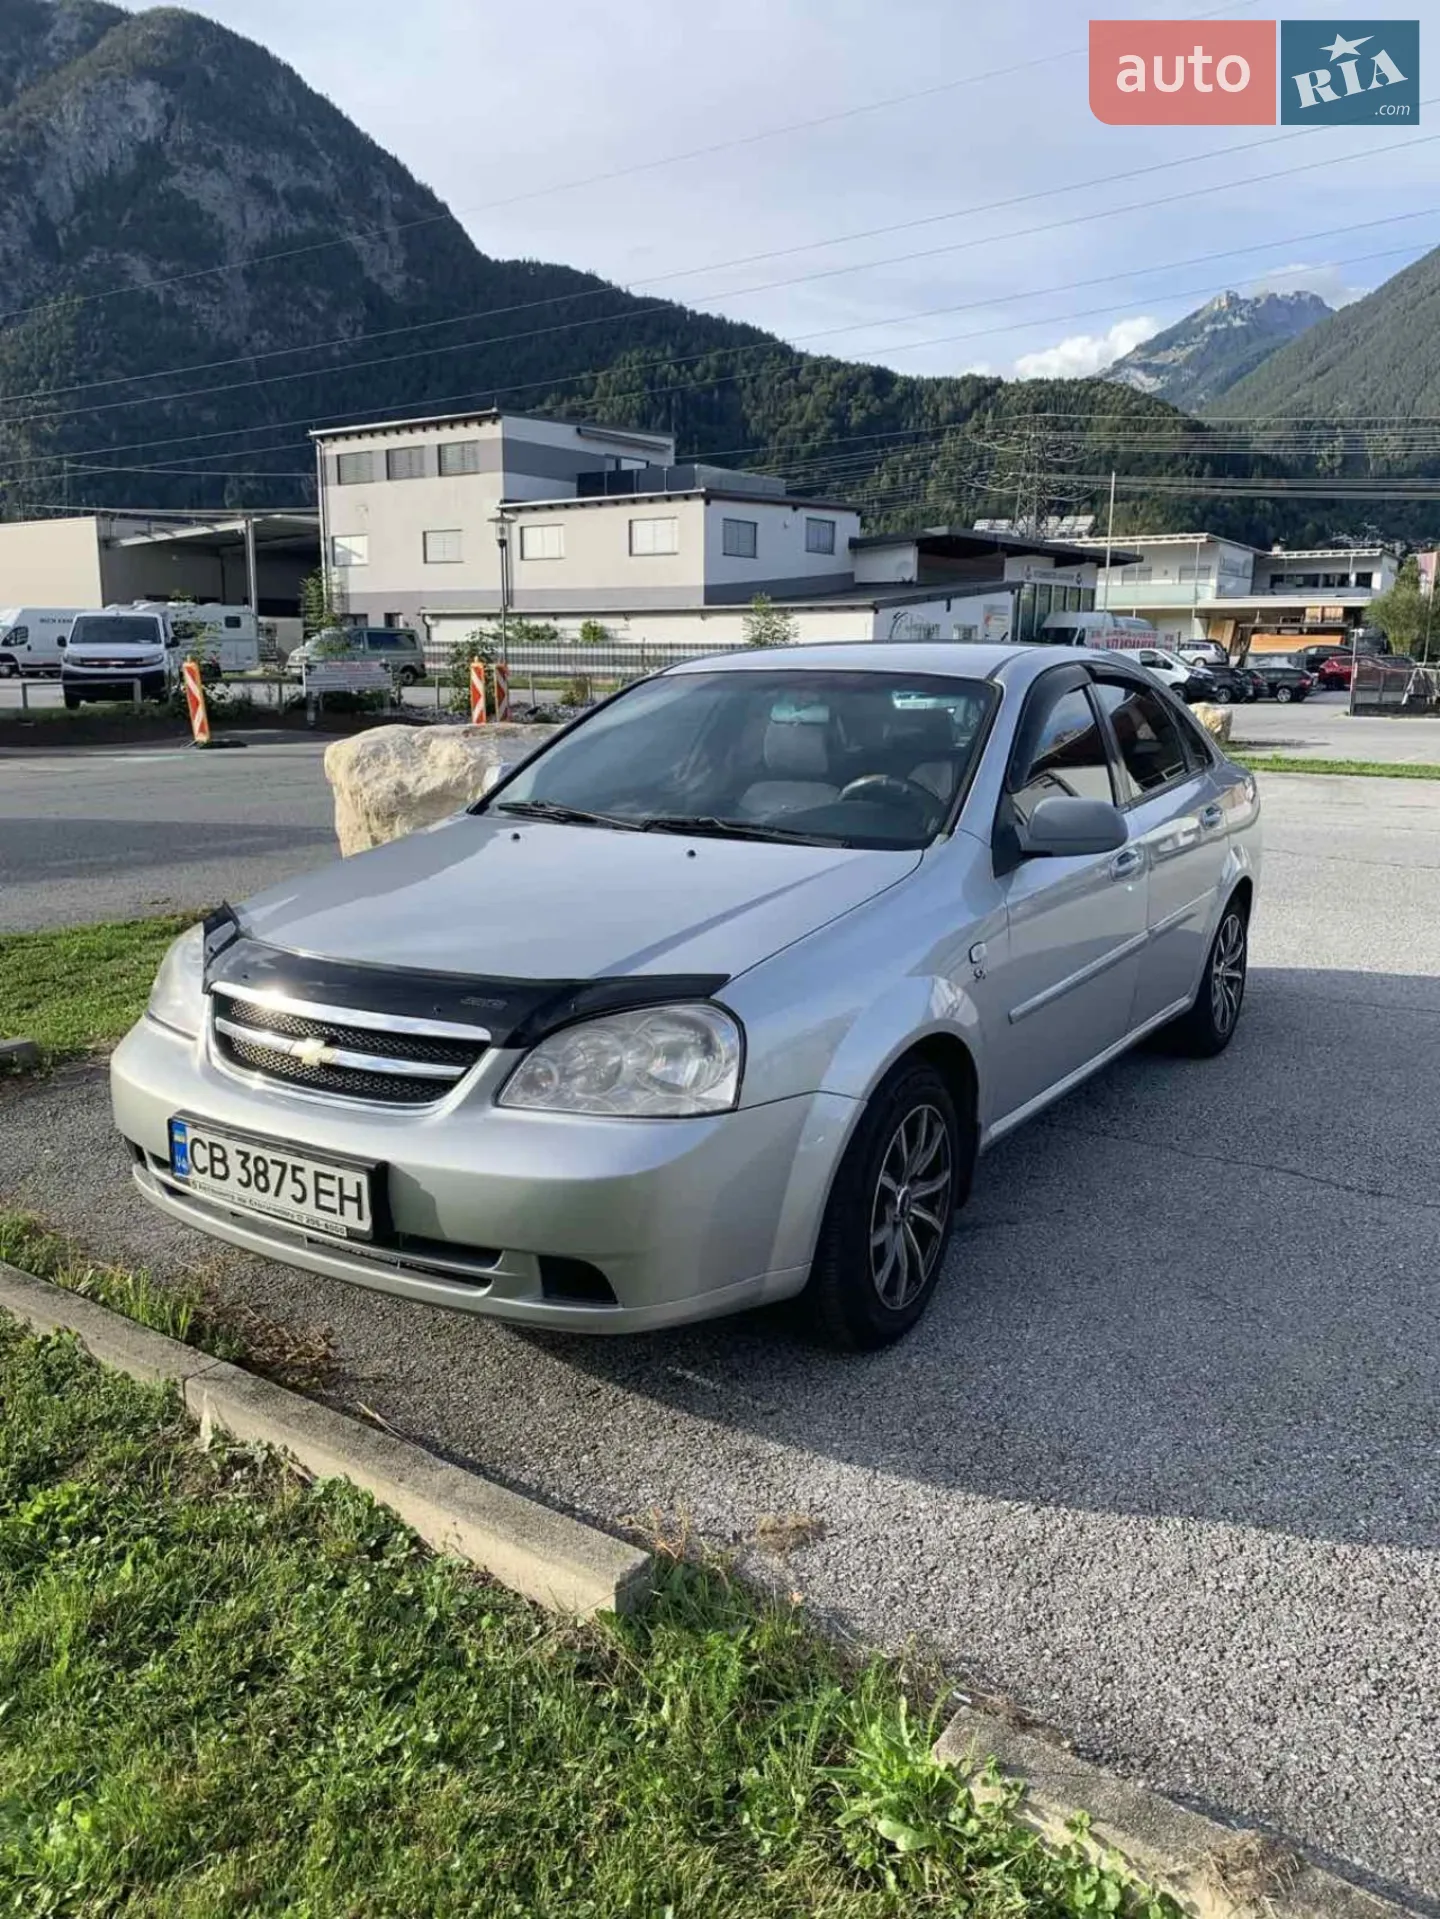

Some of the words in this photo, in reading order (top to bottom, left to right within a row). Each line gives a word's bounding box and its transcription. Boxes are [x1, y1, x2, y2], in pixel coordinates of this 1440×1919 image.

[190, 1137, 230, 1181] CB
[235, 1149, 307, 1204] 3875
[313, 1170, 363, 1221] EH
